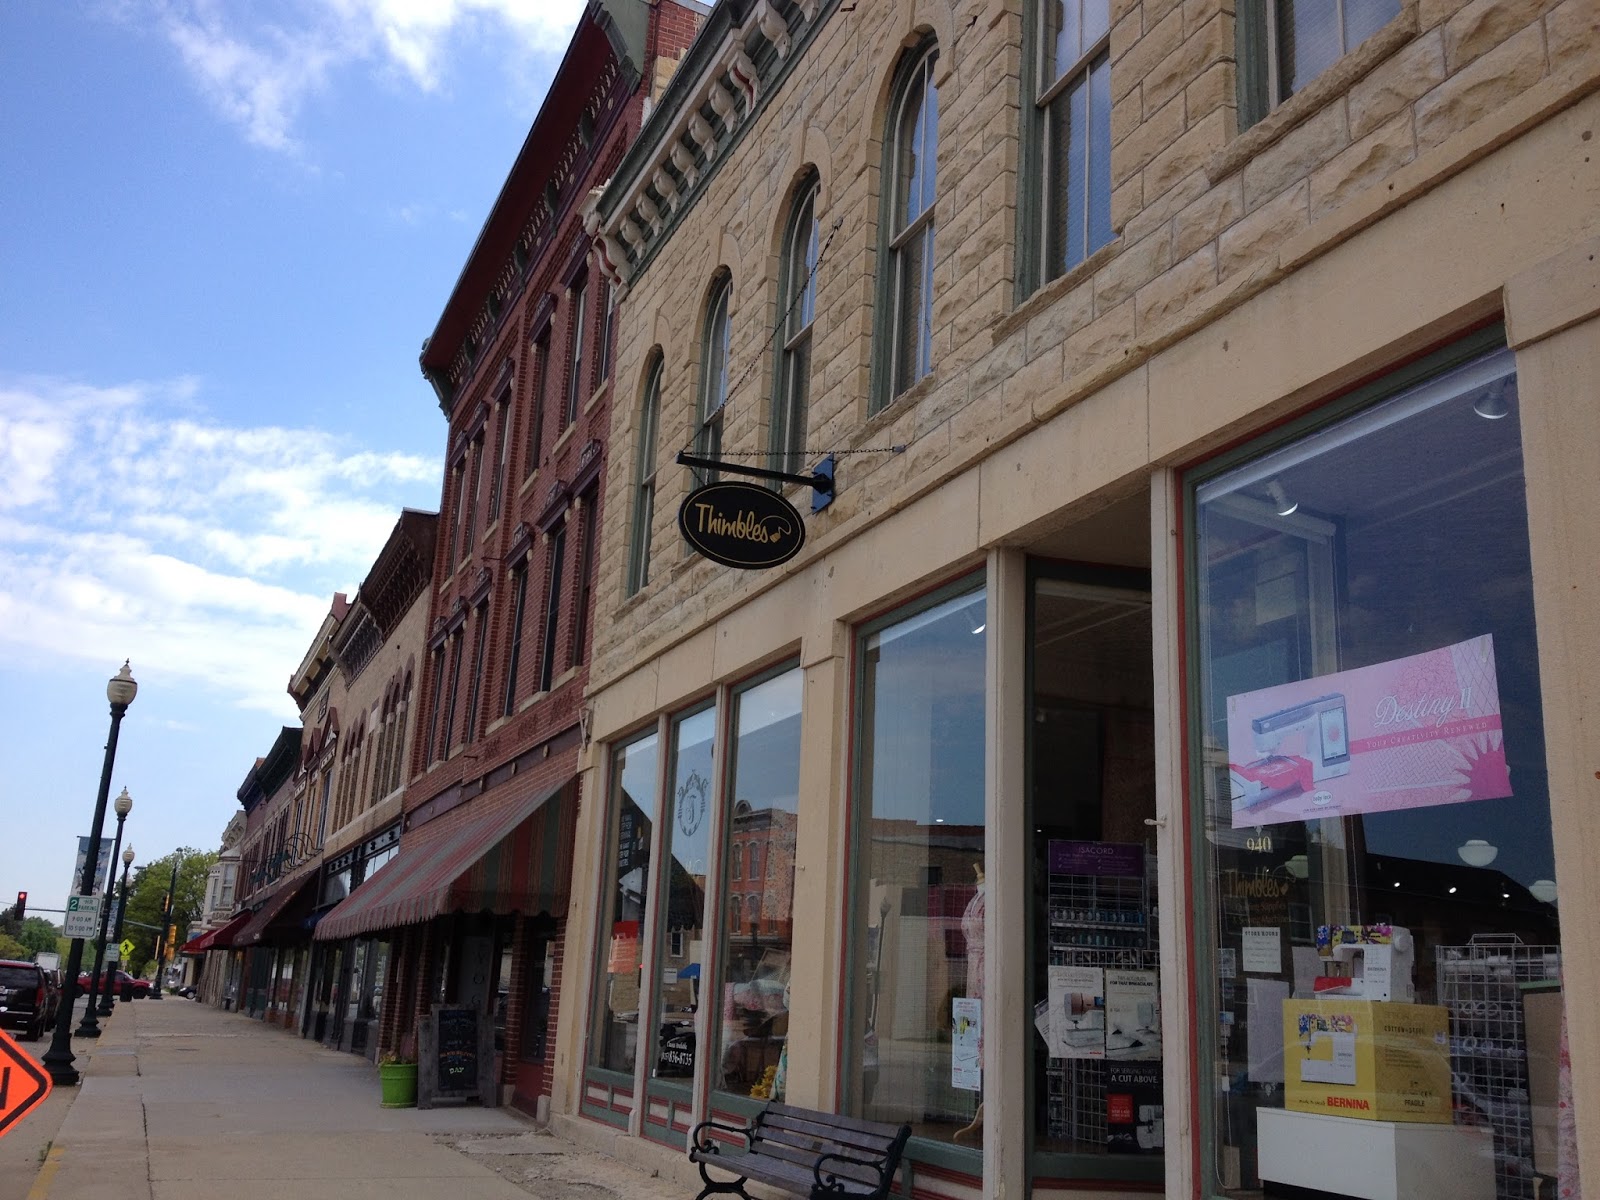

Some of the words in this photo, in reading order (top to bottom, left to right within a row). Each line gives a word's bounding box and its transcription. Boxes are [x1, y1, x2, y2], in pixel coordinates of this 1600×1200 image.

[695, 503, 769, 543] Thimbles
[1374, 694, 1457, 729] Destiny
[1366, 739, 1387, 749] YOUR
[1390, 730, 1440, 745] CREATIVITY
[1443, 722, 1488, 735] RENEWED
[1078, 846, 1114, 855] ISACORD
[1246, 836, 1272, 853] 940
[1225, 866, 1279, 898] Thimbles
[70, 899, 78, 910] 2
[1111, 1074, 1117, 1082] A
[1118, 1075, 1132, 1083] CUT
[1327, 1096, 1370, 1111] BERNINA
